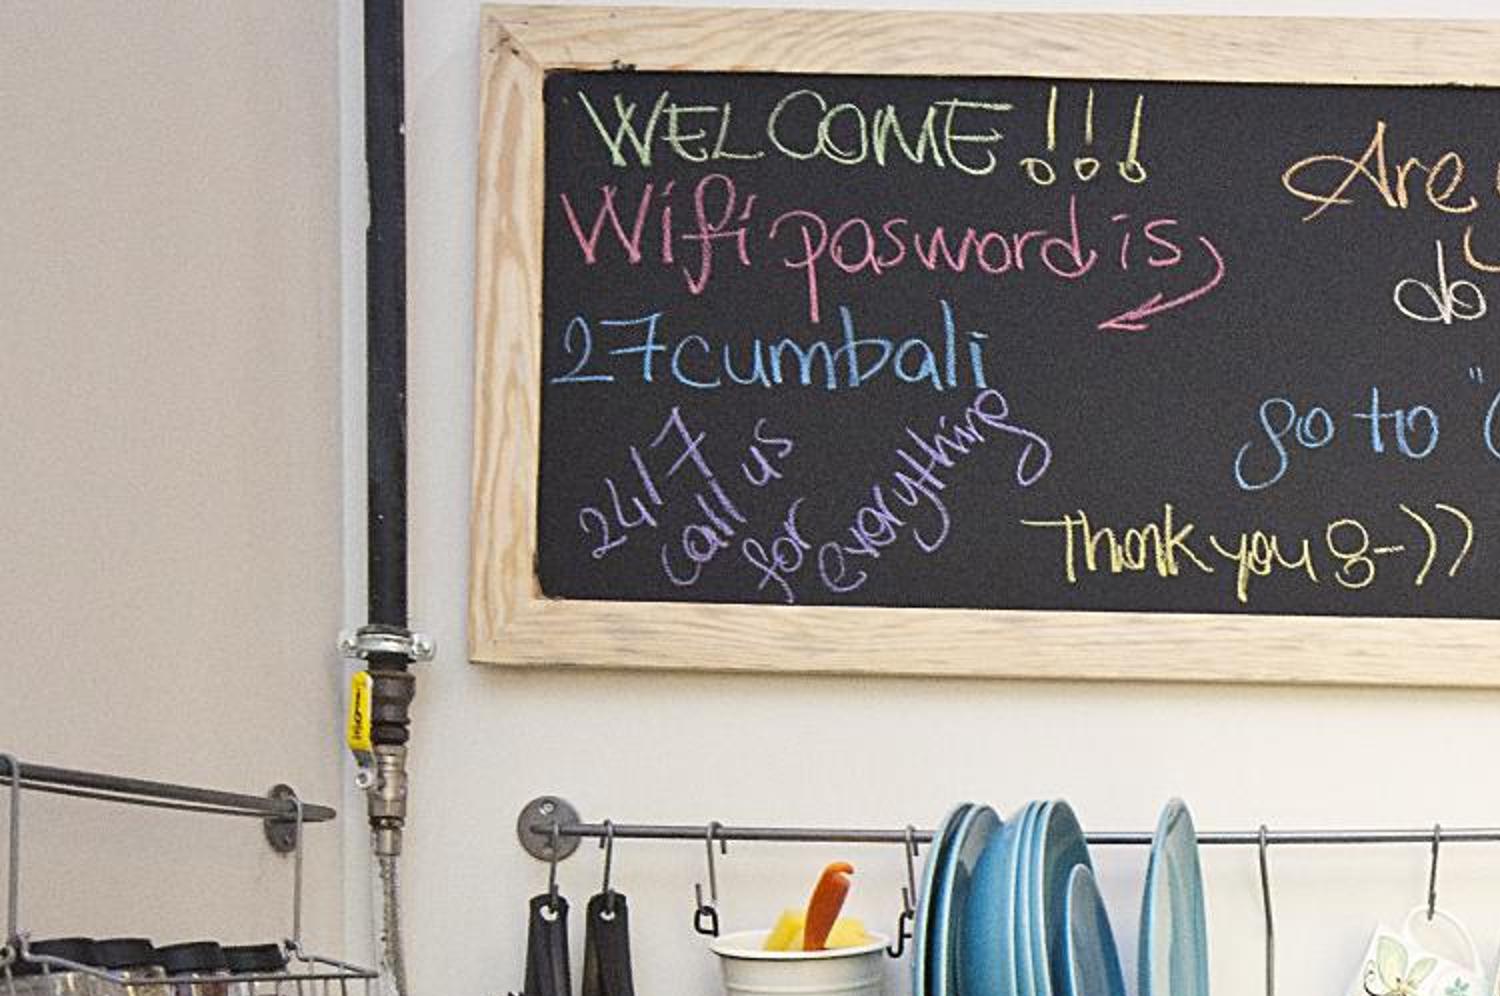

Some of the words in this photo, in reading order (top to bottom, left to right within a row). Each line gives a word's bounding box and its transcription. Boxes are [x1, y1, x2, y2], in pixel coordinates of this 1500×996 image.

[578, 86, 1147, 185] WELCOME!!!
[1281, 119, 1478, 222] Are
[560, 172, 756, 296] Wifi
[769, 194, 1098, 323] pasword
[1112, 213, 1182, 270] is
[1392, 240, 1488, 325] do
[741, 418, 793, 486] us
[1234, 397, 1336, 490] go
[1352, 386, 1441, 458] to
[741, 499, 811, 603] for
[818, 388, 1051, 593] everything
[1019, 503, 1214, 583] Thank
[1209, 532, 1319, 602] you
